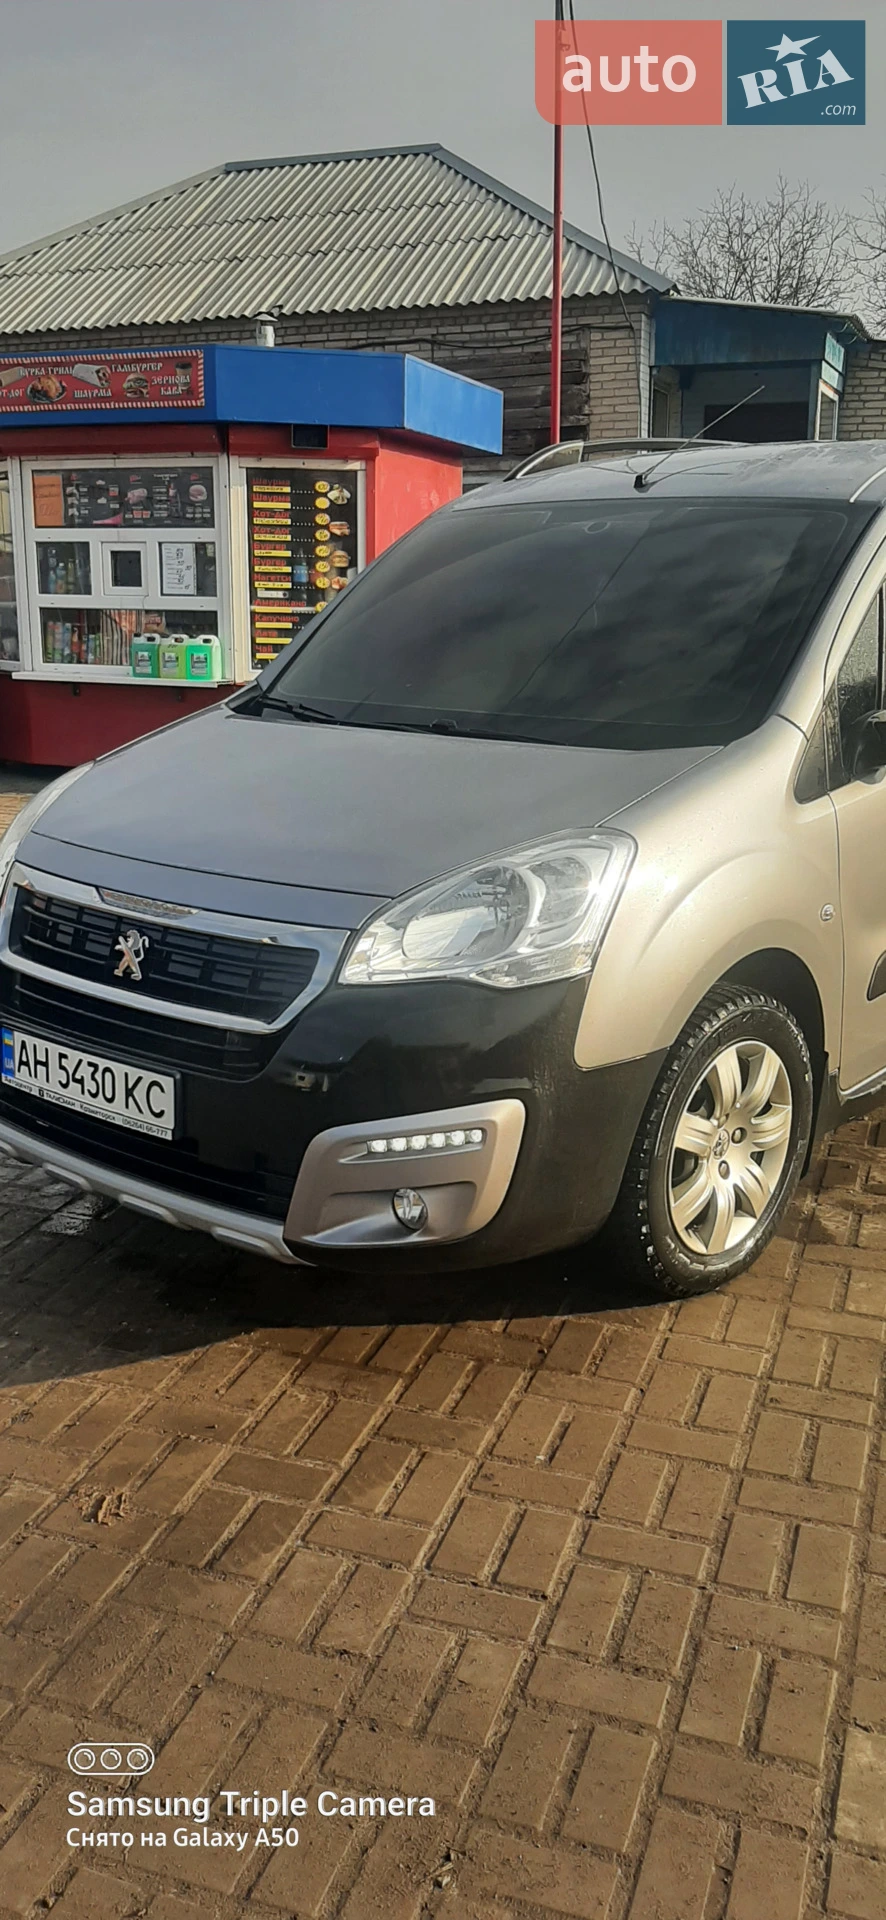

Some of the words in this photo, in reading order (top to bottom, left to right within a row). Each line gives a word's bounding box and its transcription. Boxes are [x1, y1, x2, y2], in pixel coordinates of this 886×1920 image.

[111, 362, 163, 373] ГАМБУРГЕР
[151, 374, 191, 385] ЗЕРНОВА
[74, 388, 112, 399] ШАУРМА
[252, 494, 290, 502] Шаурма
[254, 599, 306, 607] Американо
[254, 614, 299, 622] Капучино
[4, 1057, 14, 1069] UA
[17, 1040, 50, 1084] AH
[58, 1052, 116, 1104] 5430
[124, 1072, 166, 1119] KC
